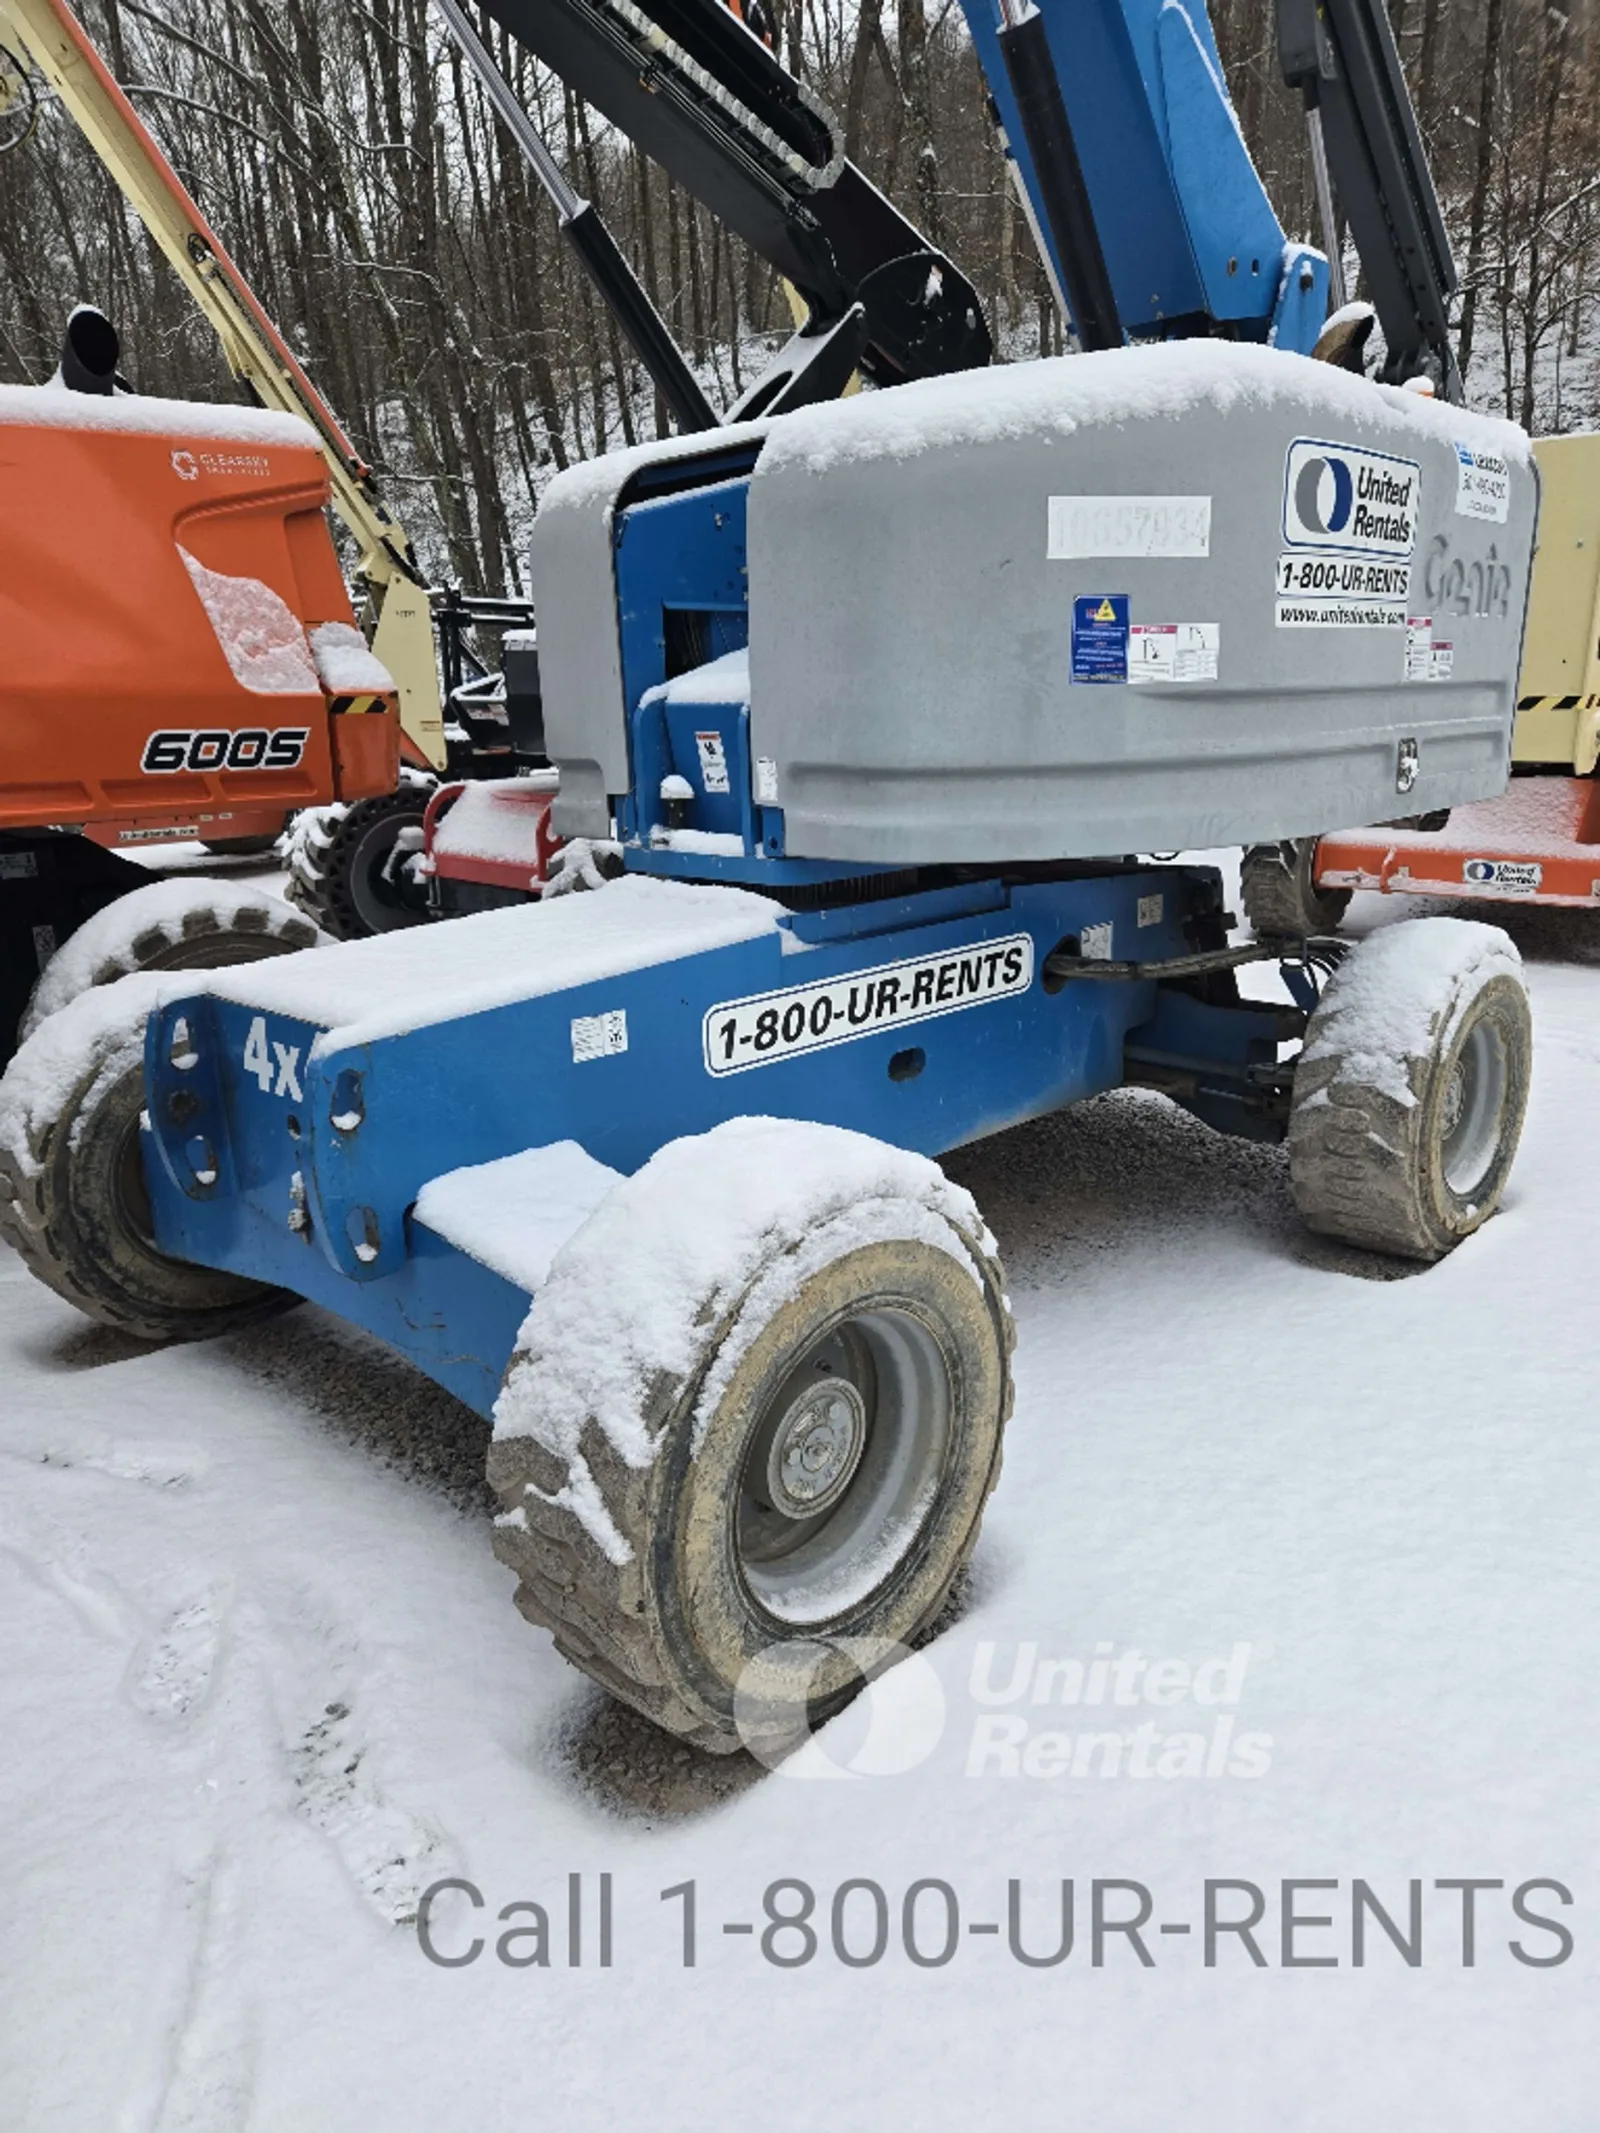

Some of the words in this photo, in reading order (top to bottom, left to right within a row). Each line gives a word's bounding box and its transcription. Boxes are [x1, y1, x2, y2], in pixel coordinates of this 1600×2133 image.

[1357, 465, 1411, 507] United
[1353, 504, 1411, 543] Rentals
[1283, 562, 1408, 595] 1-800-UR-RENTS
[1425, 533, 1511, 618] Genie
[141, 728, 310, 773] 600S
[719, 946, 1024, 1060] 1-800-UR-RENTS
